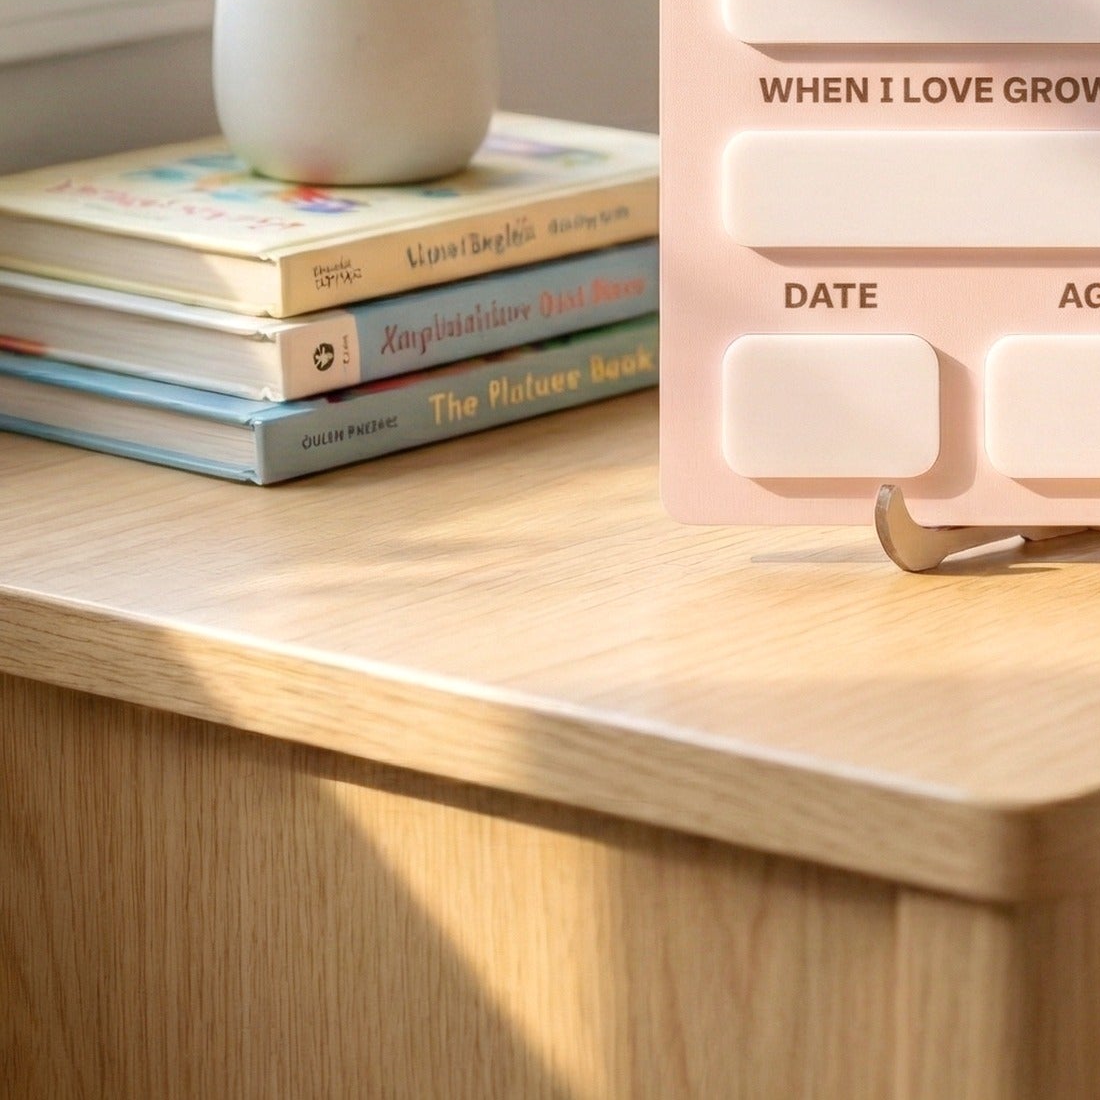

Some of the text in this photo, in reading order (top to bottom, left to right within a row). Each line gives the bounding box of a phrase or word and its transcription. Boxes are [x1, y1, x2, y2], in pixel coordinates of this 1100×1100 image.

[759, 76, 869, 104] WHEN
[880, 76, 894, 104] I
[903, 76, 994, 104] LOVE
[784, 282, 878, 310] DATE
[428, 391, 478, 425] The
